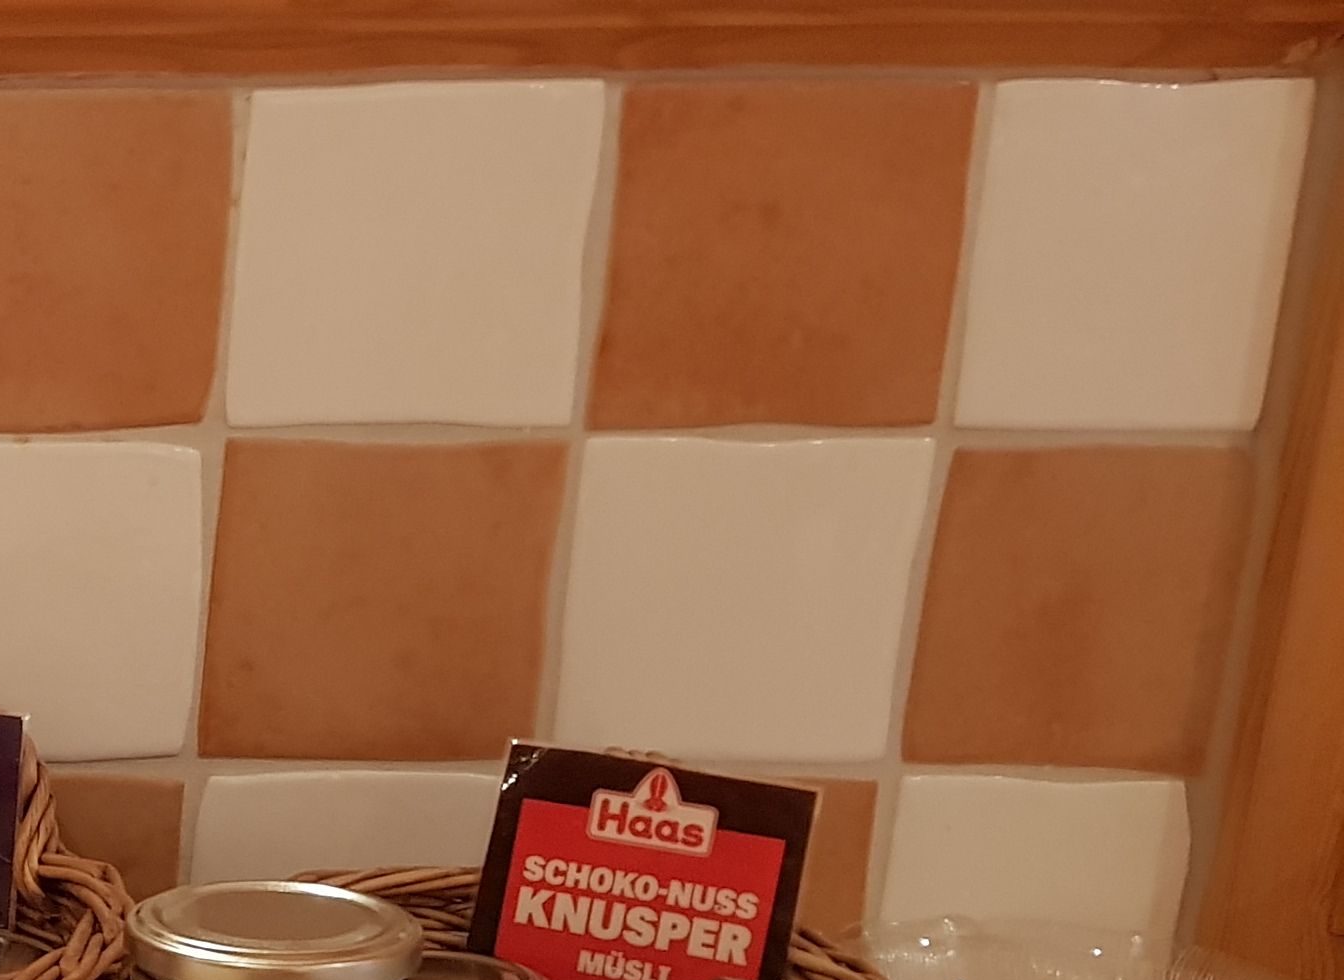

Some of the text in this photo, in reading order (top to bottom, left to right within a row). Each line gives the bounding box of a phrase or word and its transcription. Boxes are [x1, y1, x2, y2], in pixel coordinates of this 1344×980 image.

[597, 798, 705, 847] Haas
[523, 855, 760, 919] SCHOKO-NUSS
[514, 886, 753, 966] KNUSPER
